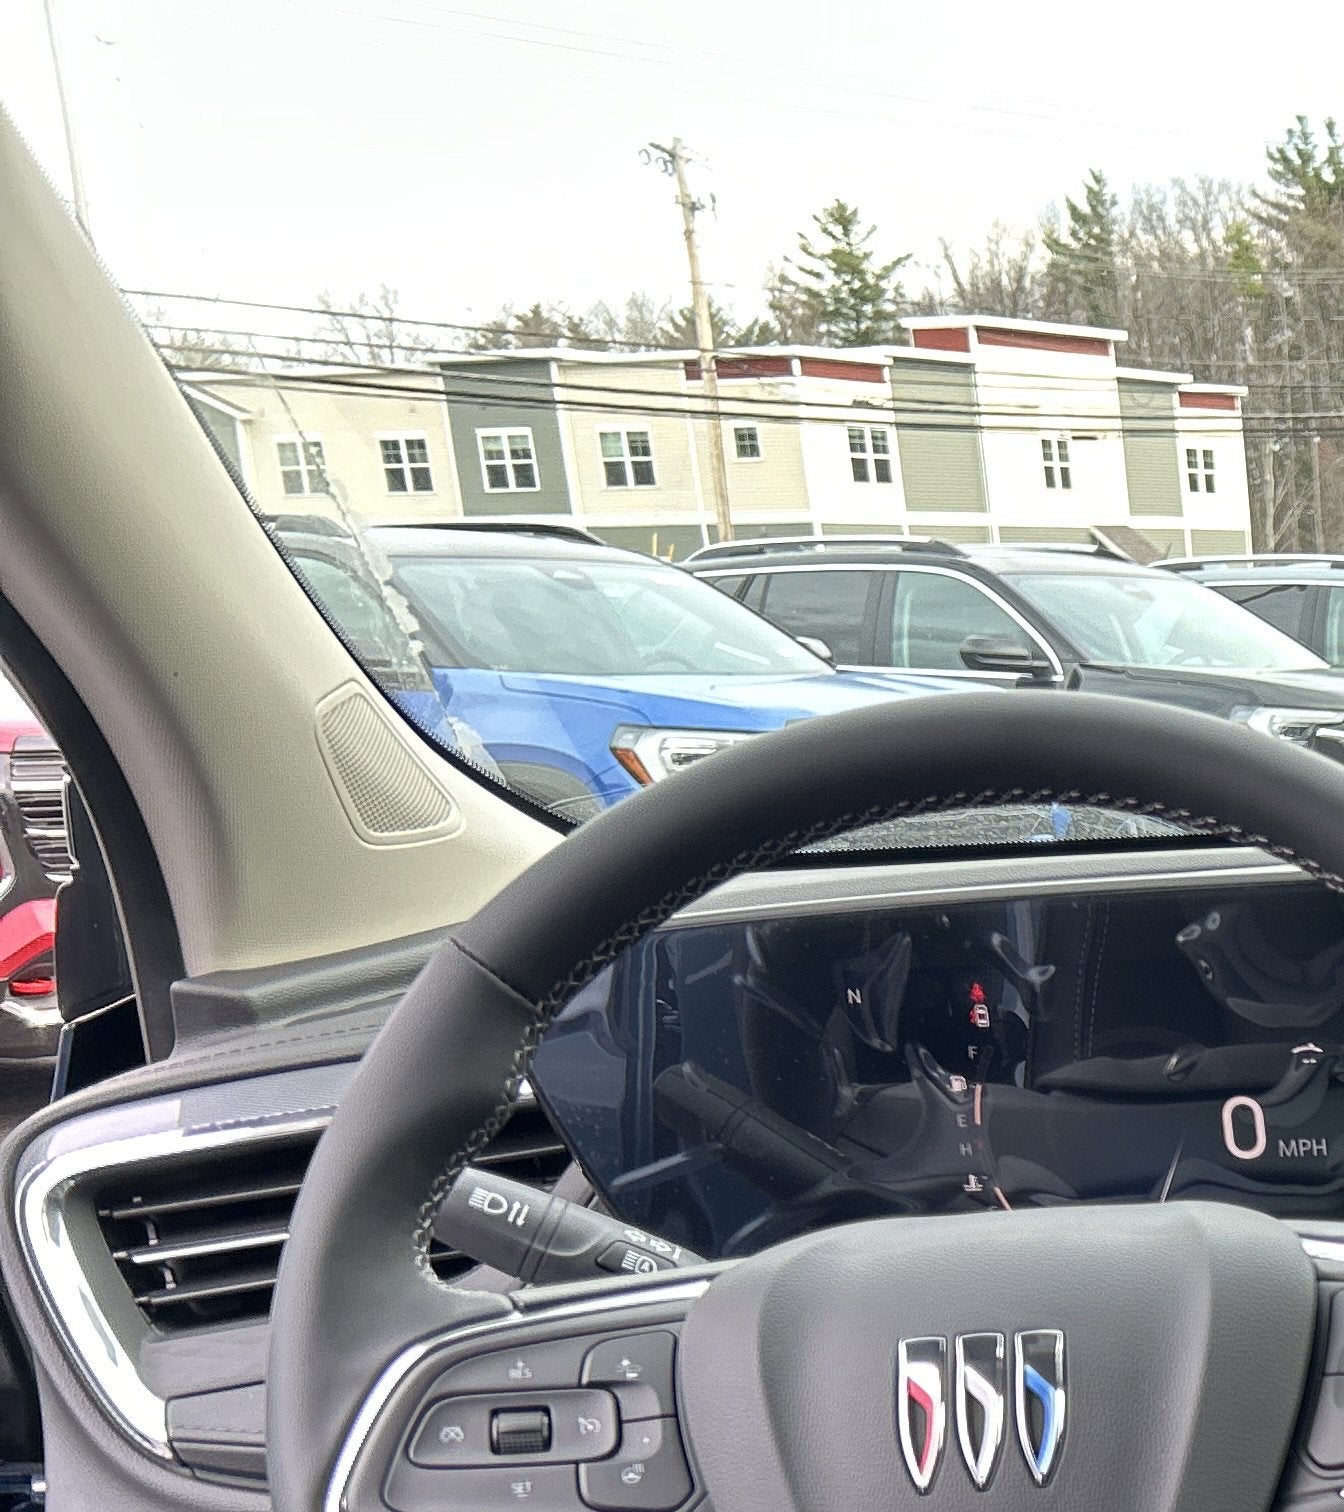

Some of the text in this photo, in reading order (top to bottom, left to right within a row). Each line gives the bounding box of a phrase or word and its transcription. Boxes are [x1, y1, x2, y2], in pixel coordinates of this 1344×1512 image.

[847, 988, 861, 1004] N
[967, 1045, 978, 1059] F
[956, 1114, 968, 1127] E
[1221, 1096, 1328, 1159] 0 MPH
[959, 1142, 972, 1155] H
